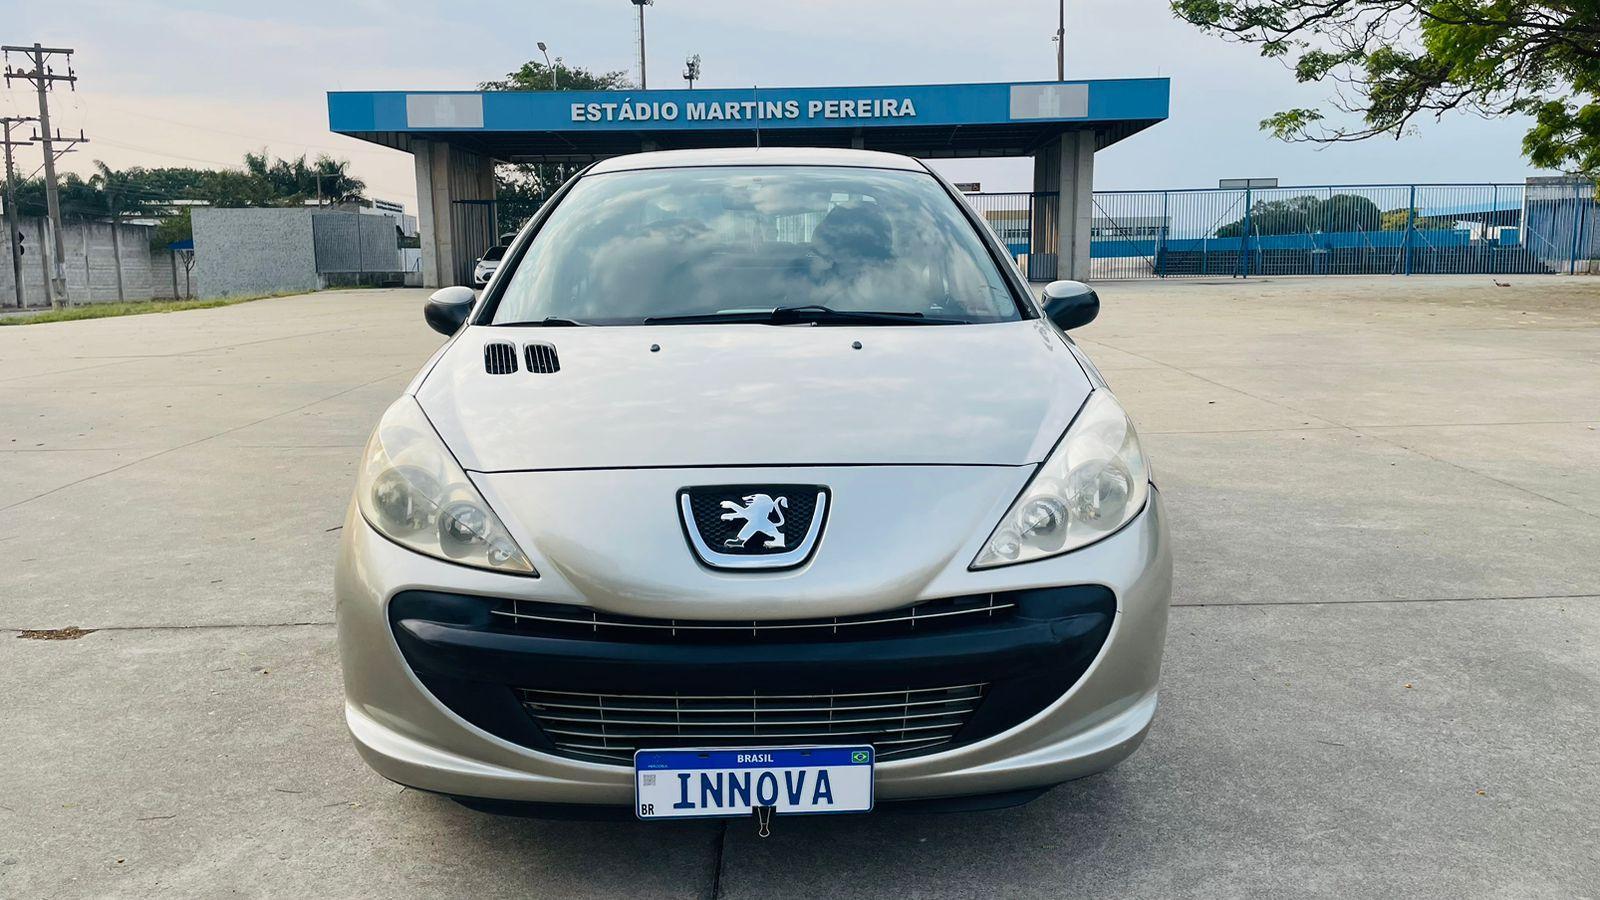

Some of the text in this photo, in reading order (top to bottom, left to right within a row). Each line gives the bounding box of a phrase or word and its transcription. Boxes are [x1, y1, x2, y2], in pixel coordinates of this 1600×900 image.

[570, 97, 917, 121] ESTÁDIO MARTINS PEREIRA
[737, 754, 774, 763] BRASIL
[673, 769, 834, 809] INNOVA
[641, 804, 655, 816] BR
